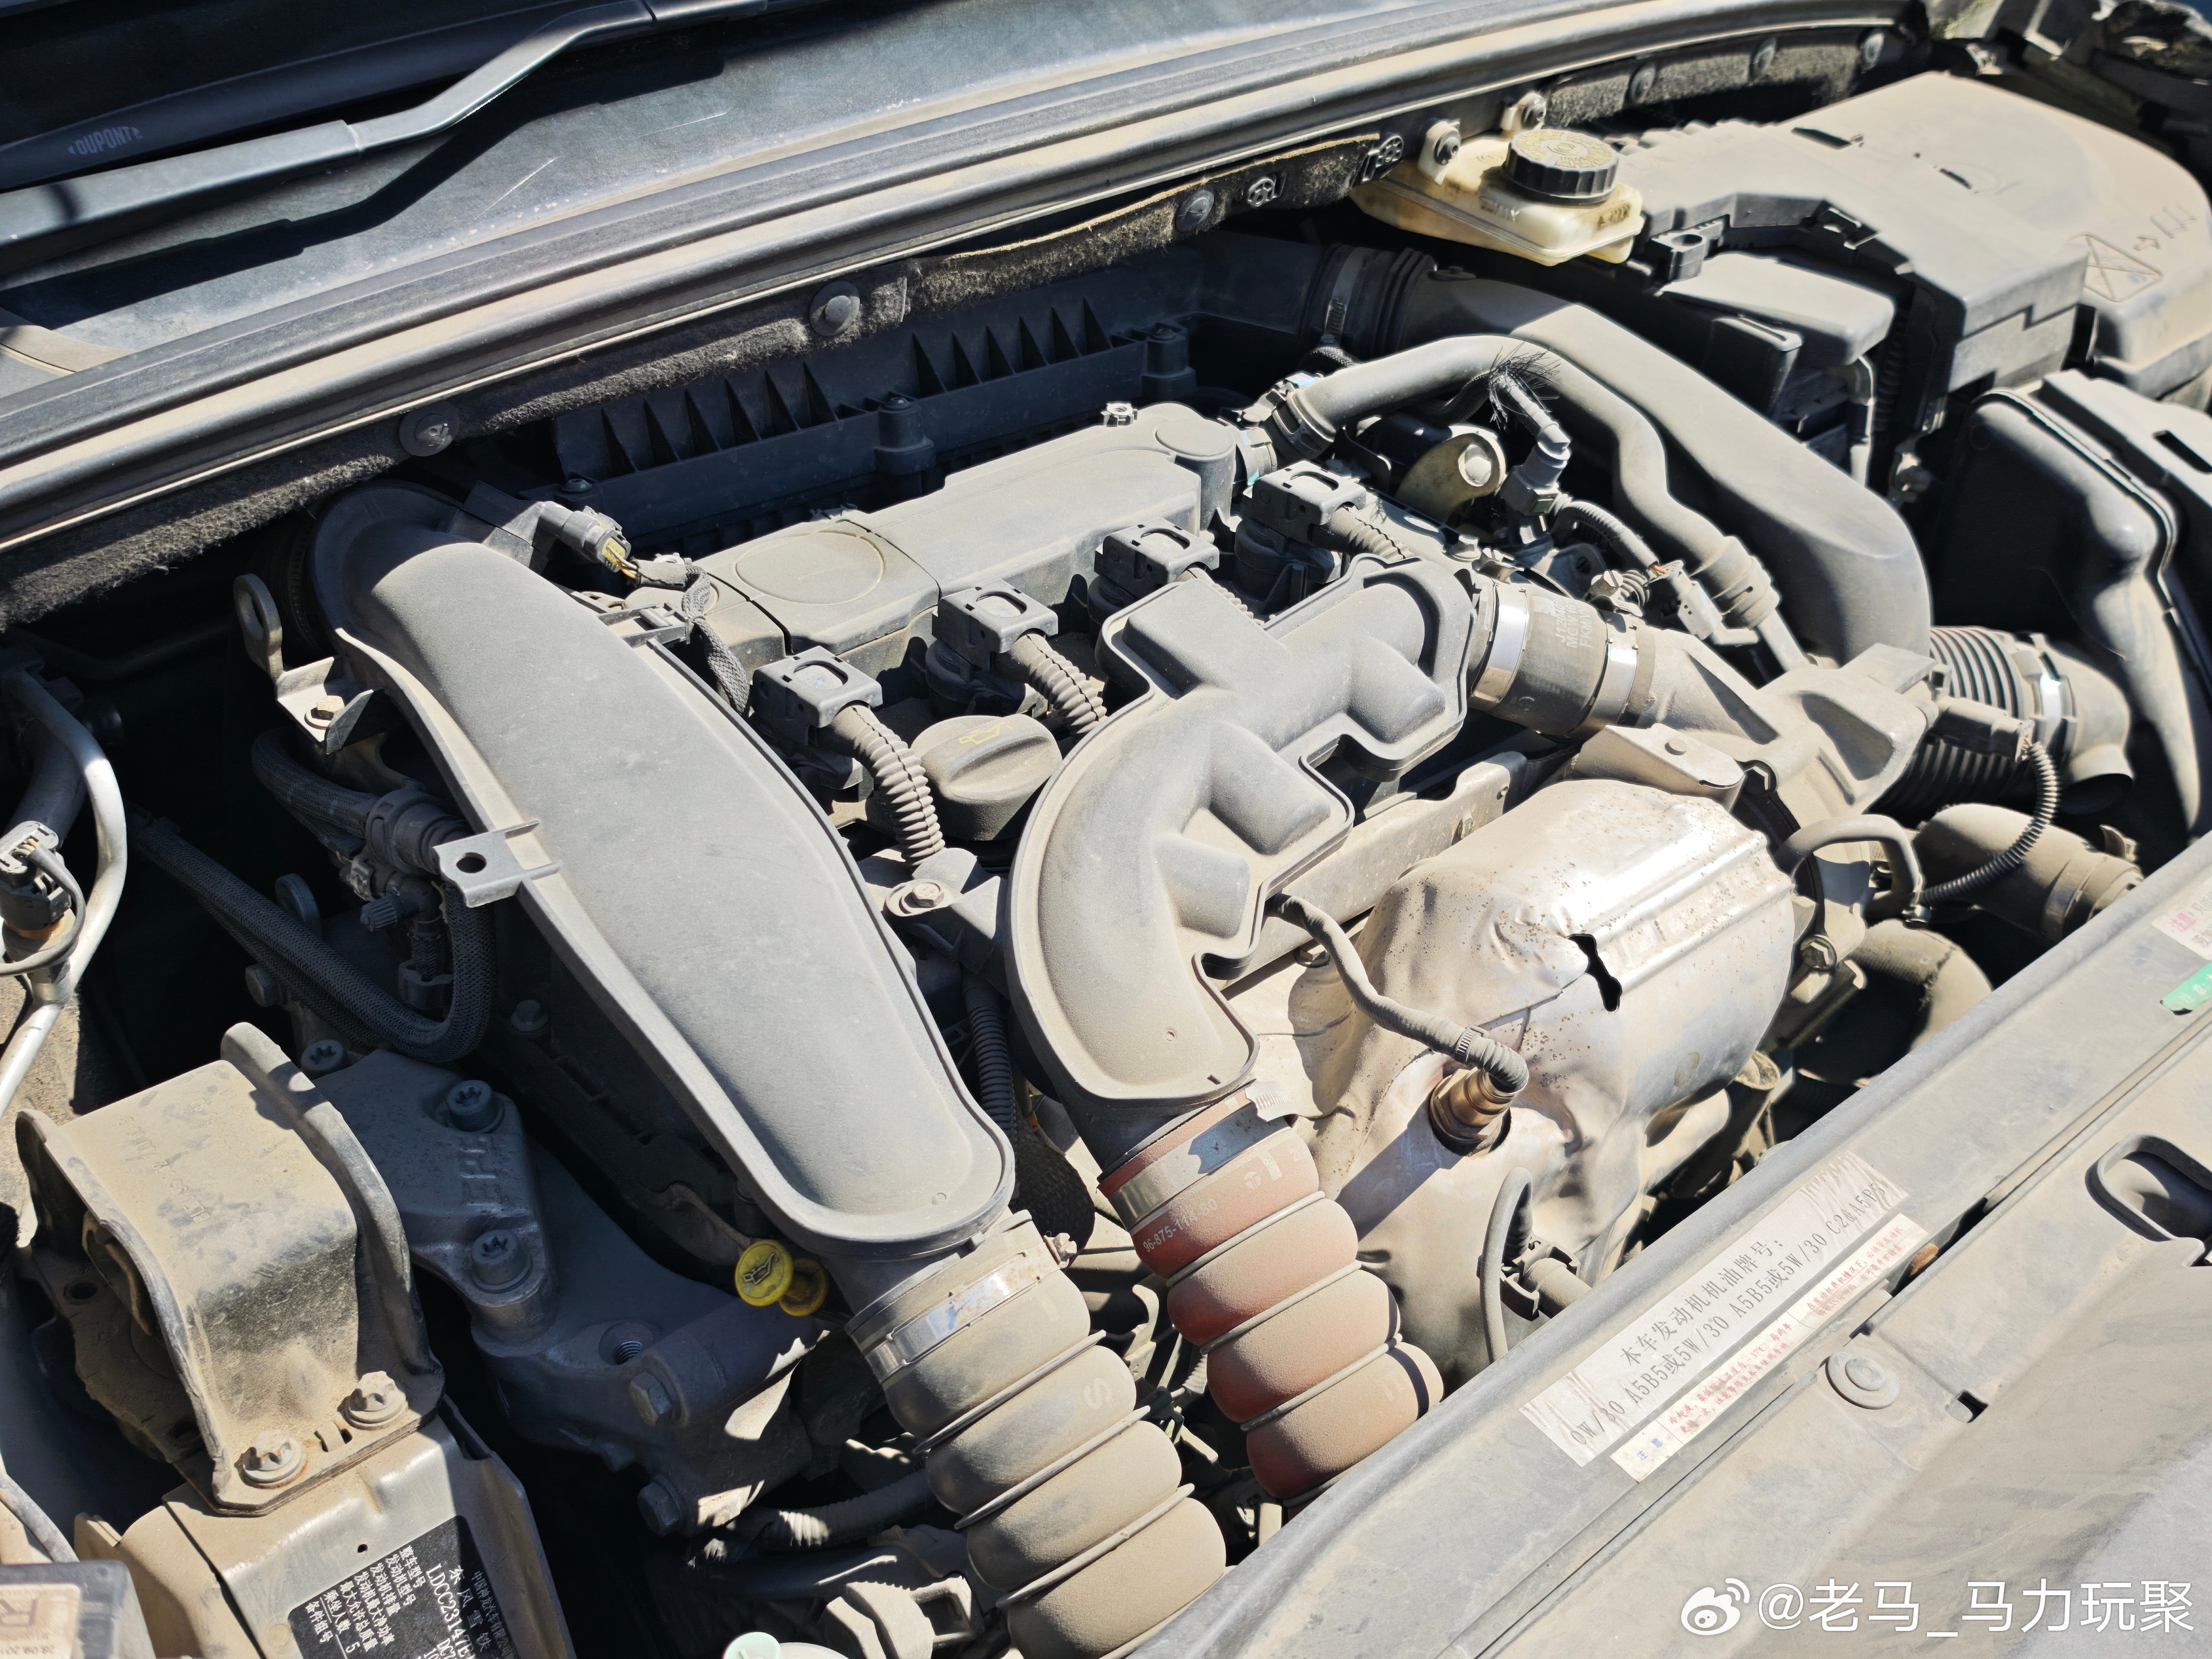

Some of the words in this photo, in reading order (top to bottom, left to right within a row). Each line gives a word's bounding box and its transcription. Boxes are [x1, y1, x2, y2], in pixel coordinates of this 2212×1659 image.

[75, 126, 134, 156] DUPONT
[1625, 1315, 1730, 1406] A5B5或5W/30
[1731, 1232, 1828, 1318] A5B5或5W/30
[369, 1562, 402, 1617] 发动机排量
[385, 1553, 416, 1606] 发动机型号
[345, 1641, 361, 1654] 5
